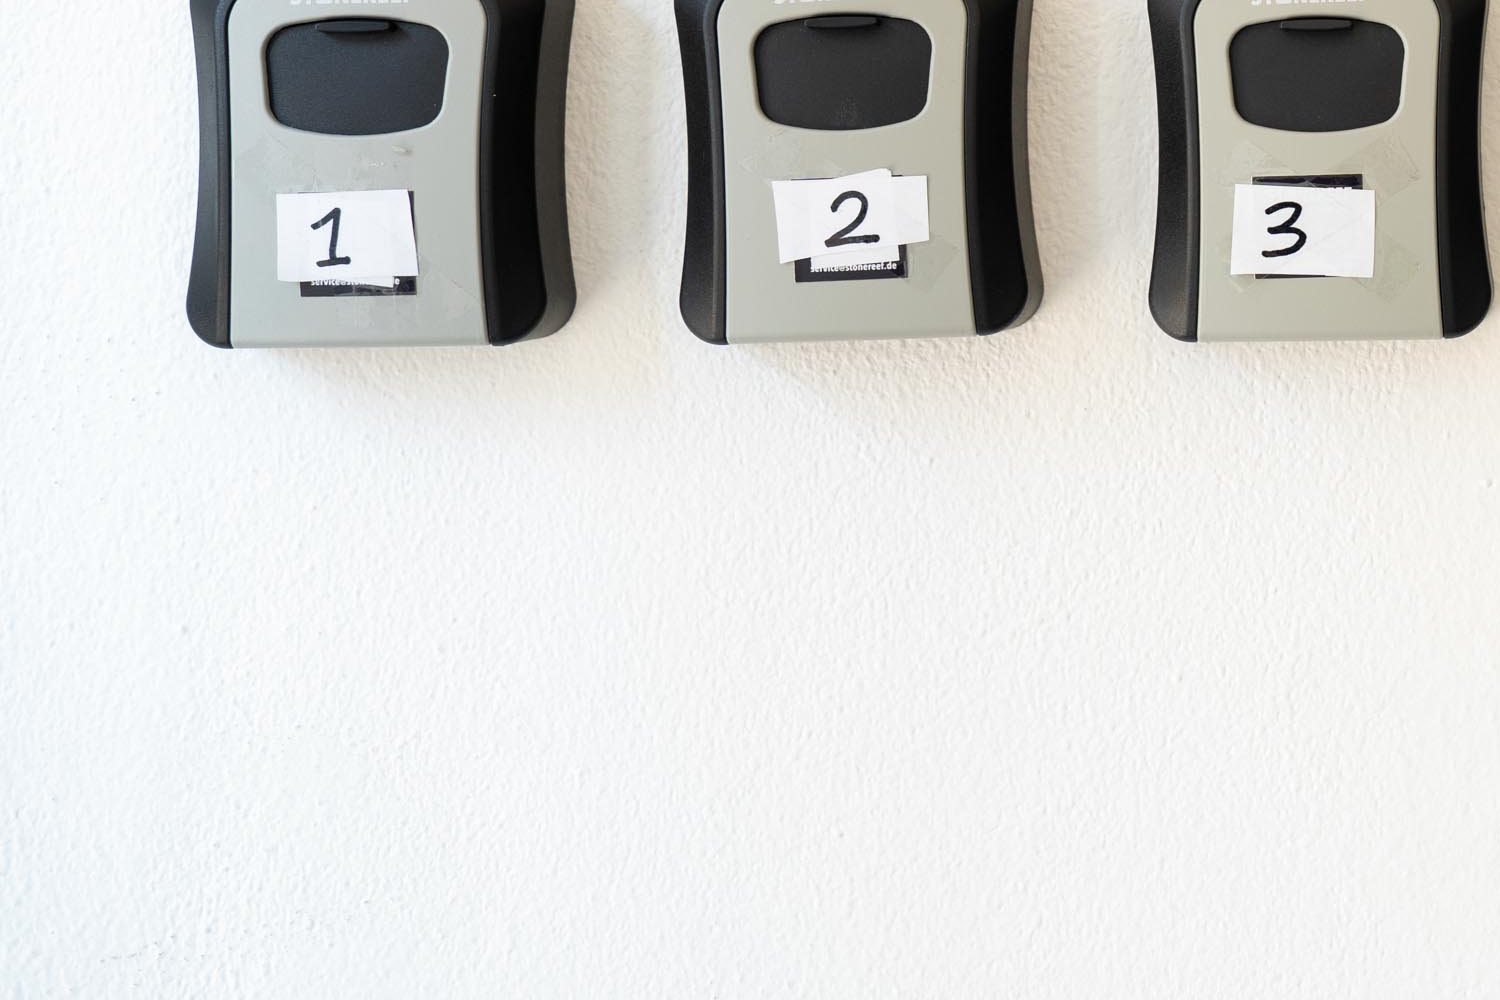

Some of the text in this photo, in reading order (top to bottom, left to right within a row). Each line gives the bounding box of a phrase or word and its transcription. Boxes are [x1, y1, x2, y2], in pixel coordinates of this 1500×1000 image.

[310, 207, 351, 267] 1
[824, 190, 880, 248] 2
[1261, 201, 1306, 258] 3
